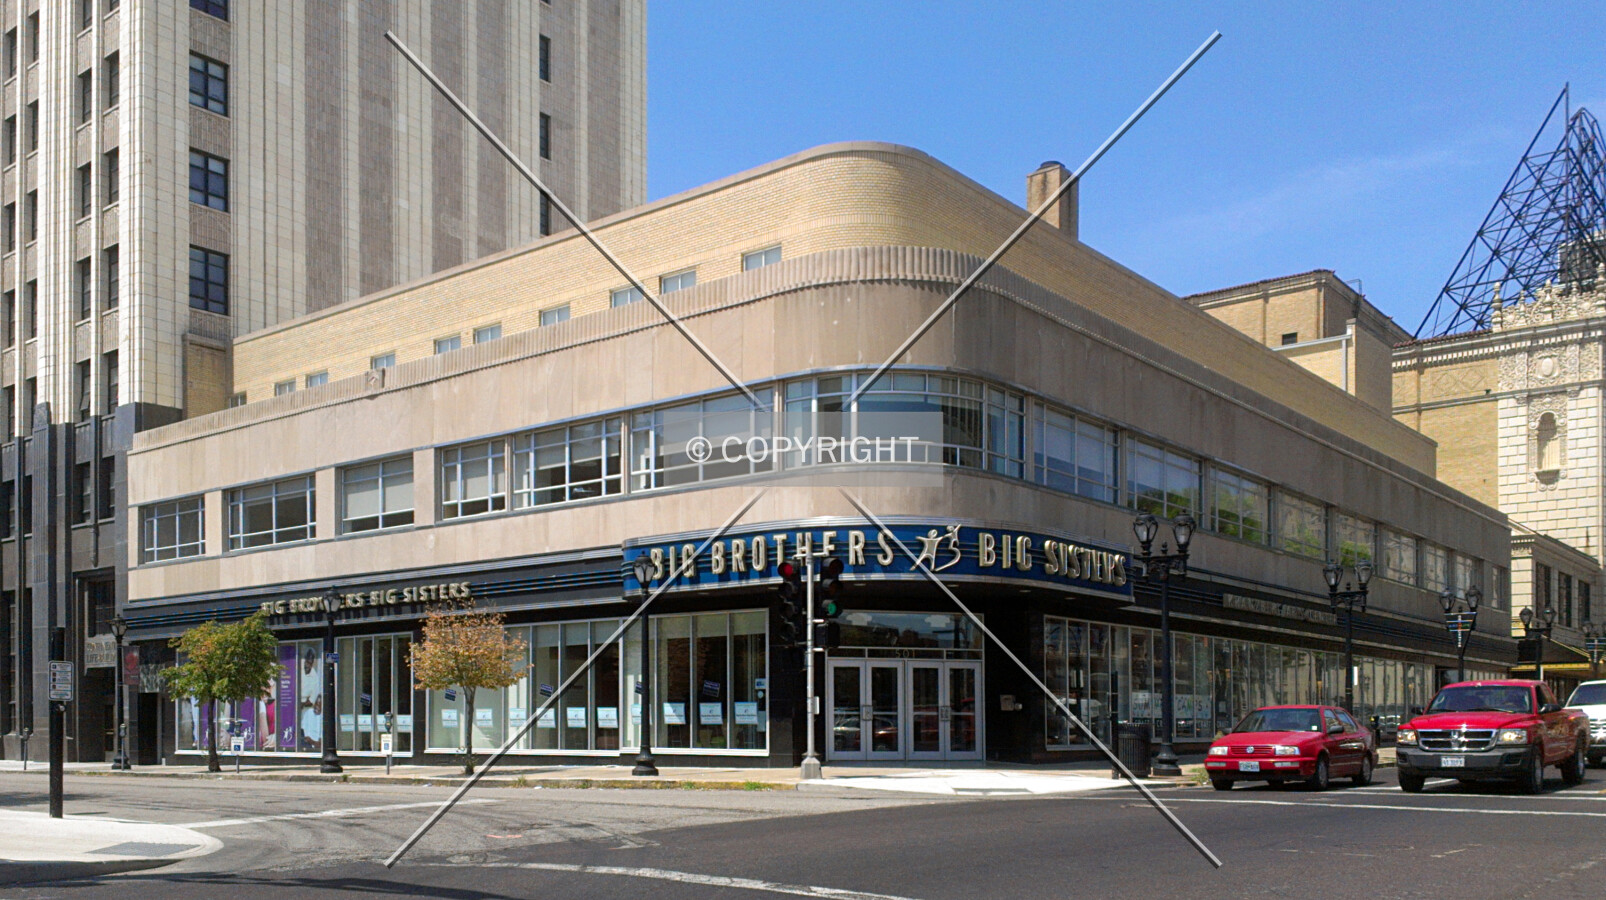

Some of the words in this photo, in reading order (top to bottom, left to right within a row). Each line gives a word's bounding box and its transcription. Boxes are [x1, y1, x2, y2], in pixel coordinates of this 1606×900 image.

[651, 543, 695, 580] BIG
[711, 530, 894, 575] BROTHERS
[978, 532, 1032, 571] BIG
[1044, 539, 1127, 587] SISTERS
[370, 588, 398, 606] BIG
[403, 581, 471, 602] SISTERS
